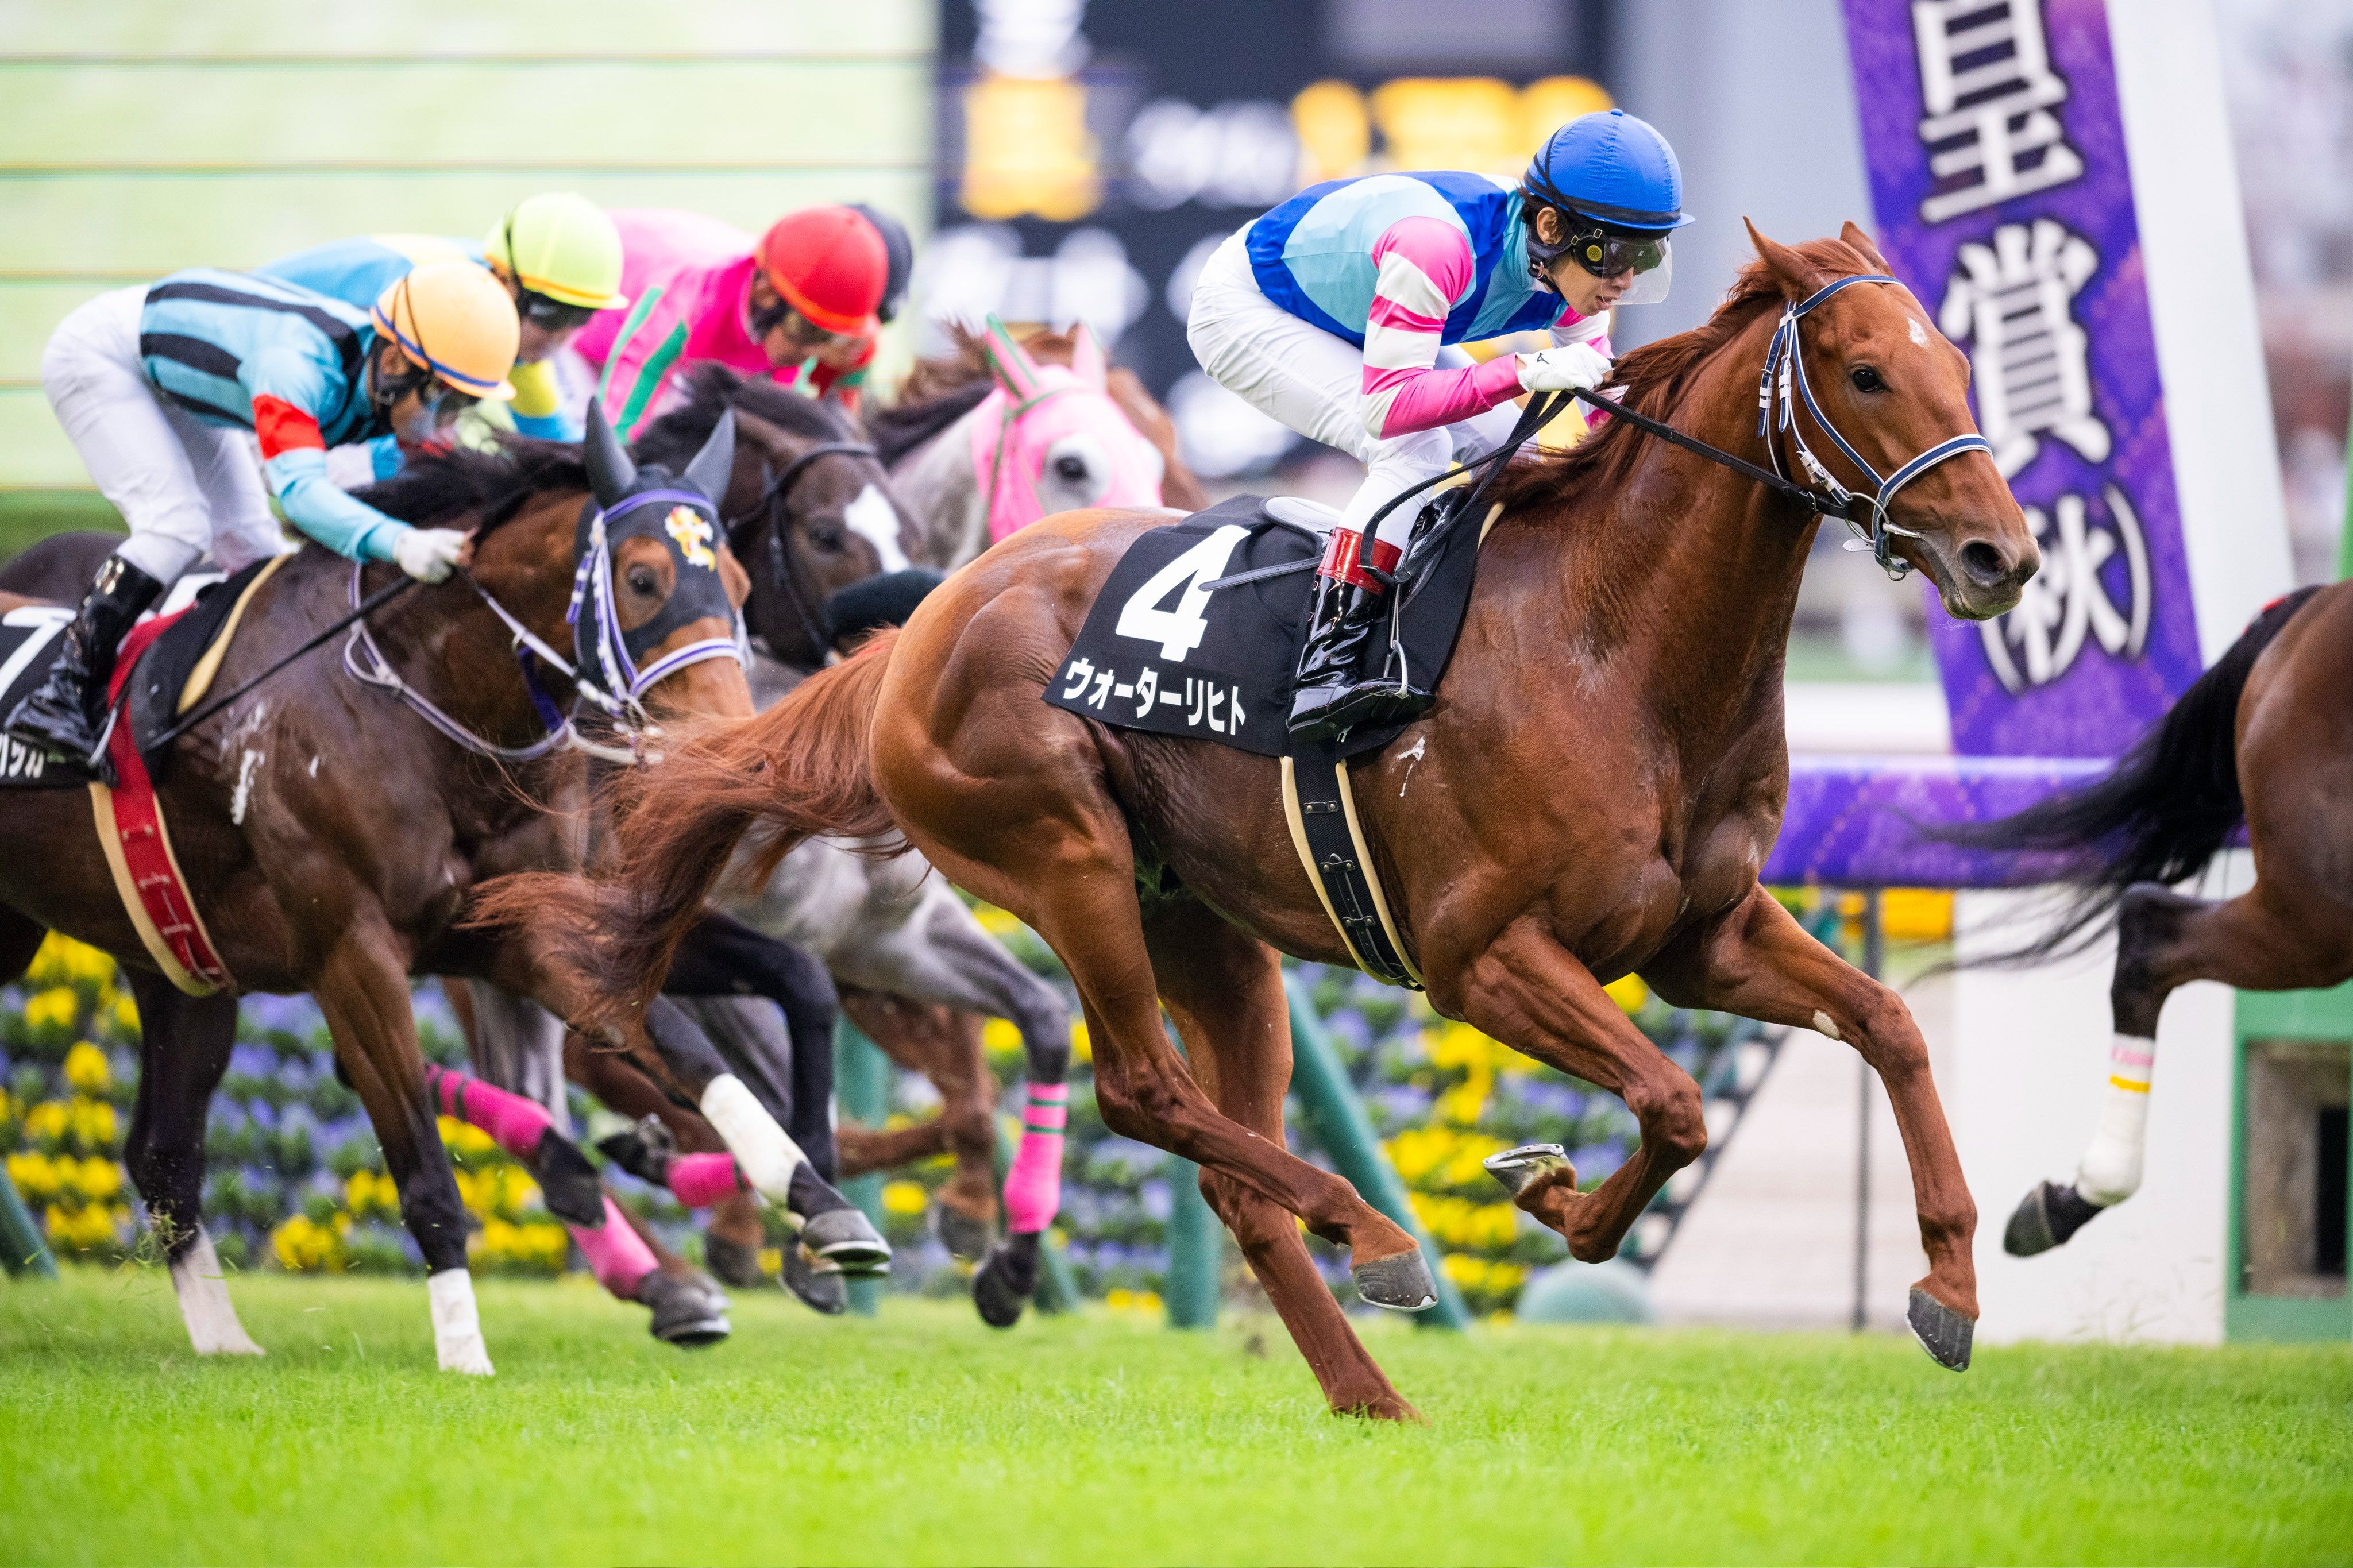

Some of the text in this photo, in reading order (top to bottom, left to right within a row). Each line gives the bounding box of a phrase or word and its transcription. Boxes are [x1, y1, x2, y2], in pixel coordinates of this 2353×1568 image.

[1116, 525, 1251, 662] 4
[1063, 658, 1246, 736] ウォーターリヒト
